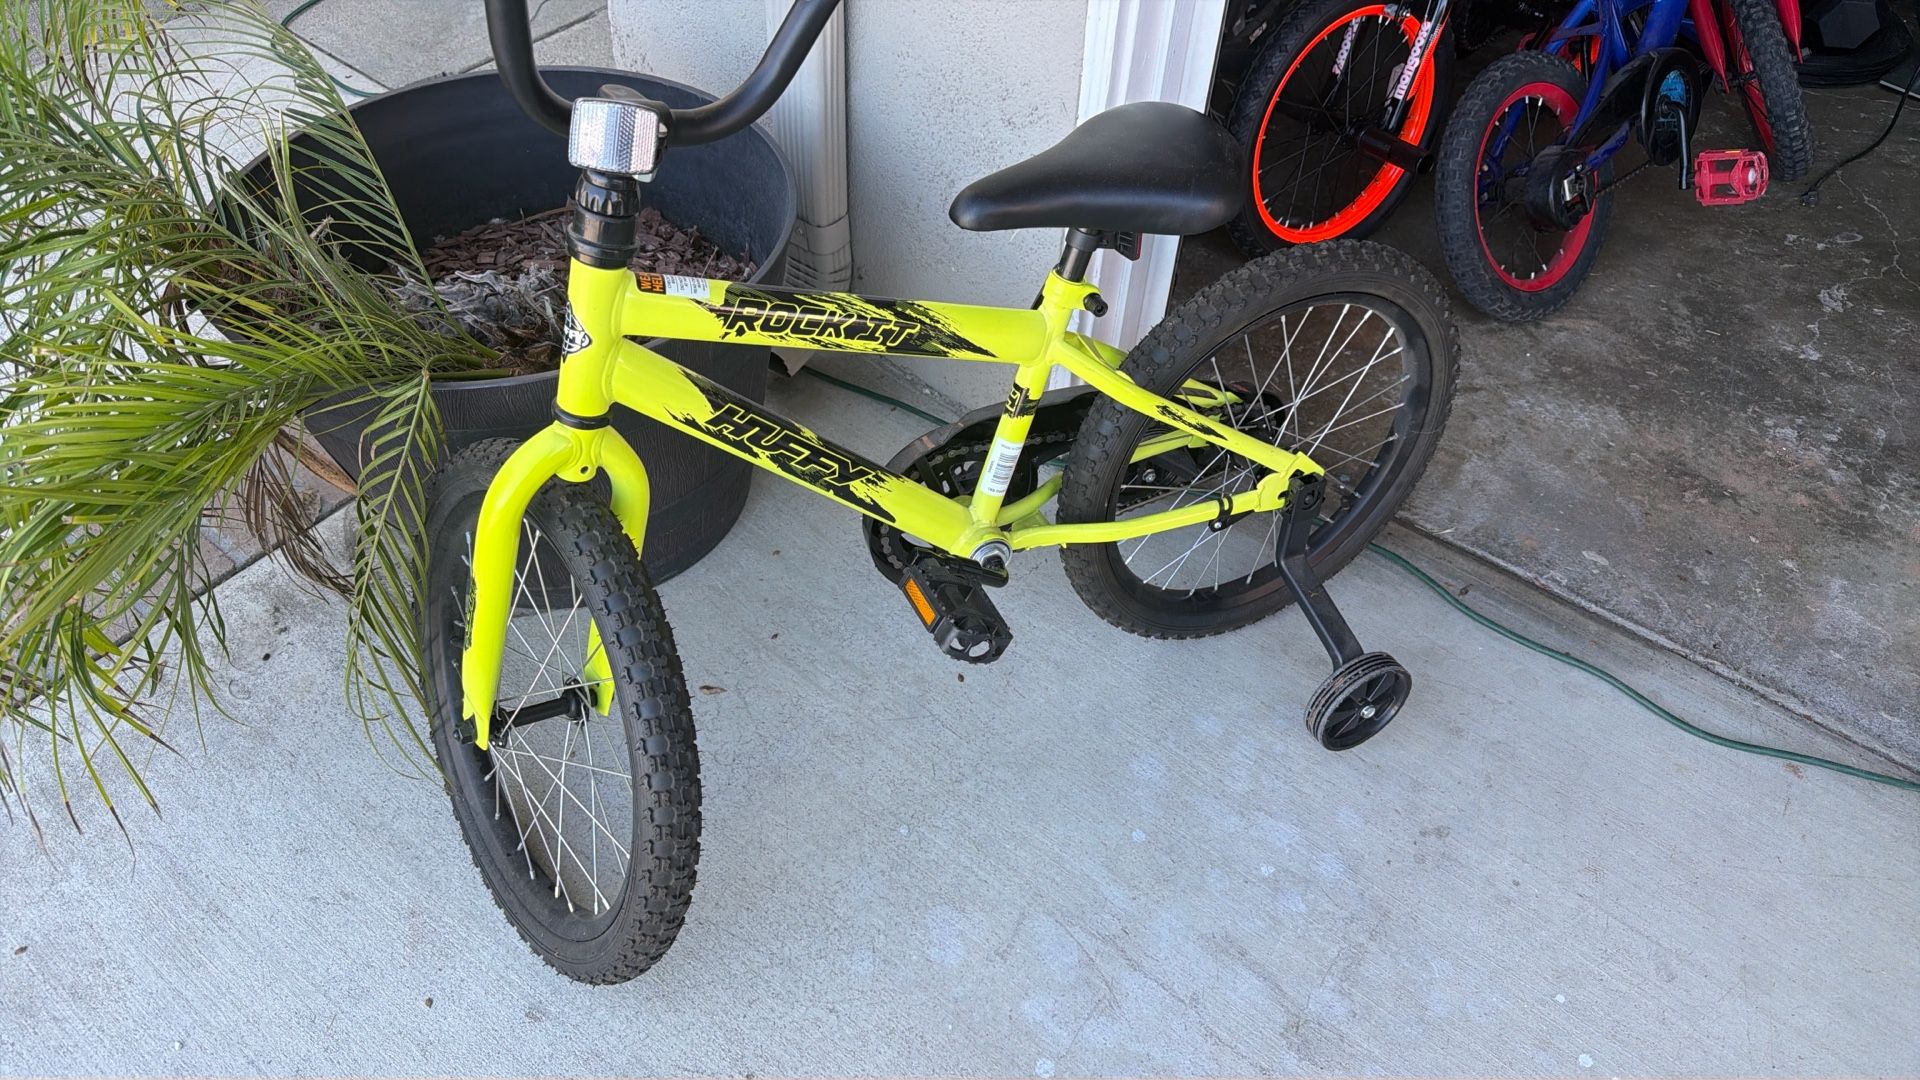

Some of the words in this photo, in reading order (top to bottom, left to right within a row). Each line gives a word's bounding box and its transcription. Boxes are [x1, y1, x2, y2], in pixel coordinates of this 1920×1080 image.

[1394, 21, 1431, 100] mongoose
[724, 297, 857, 338] ROCK
[854, 316, 921, 347] IT
[704, 403, 875, 486] HUFFY
